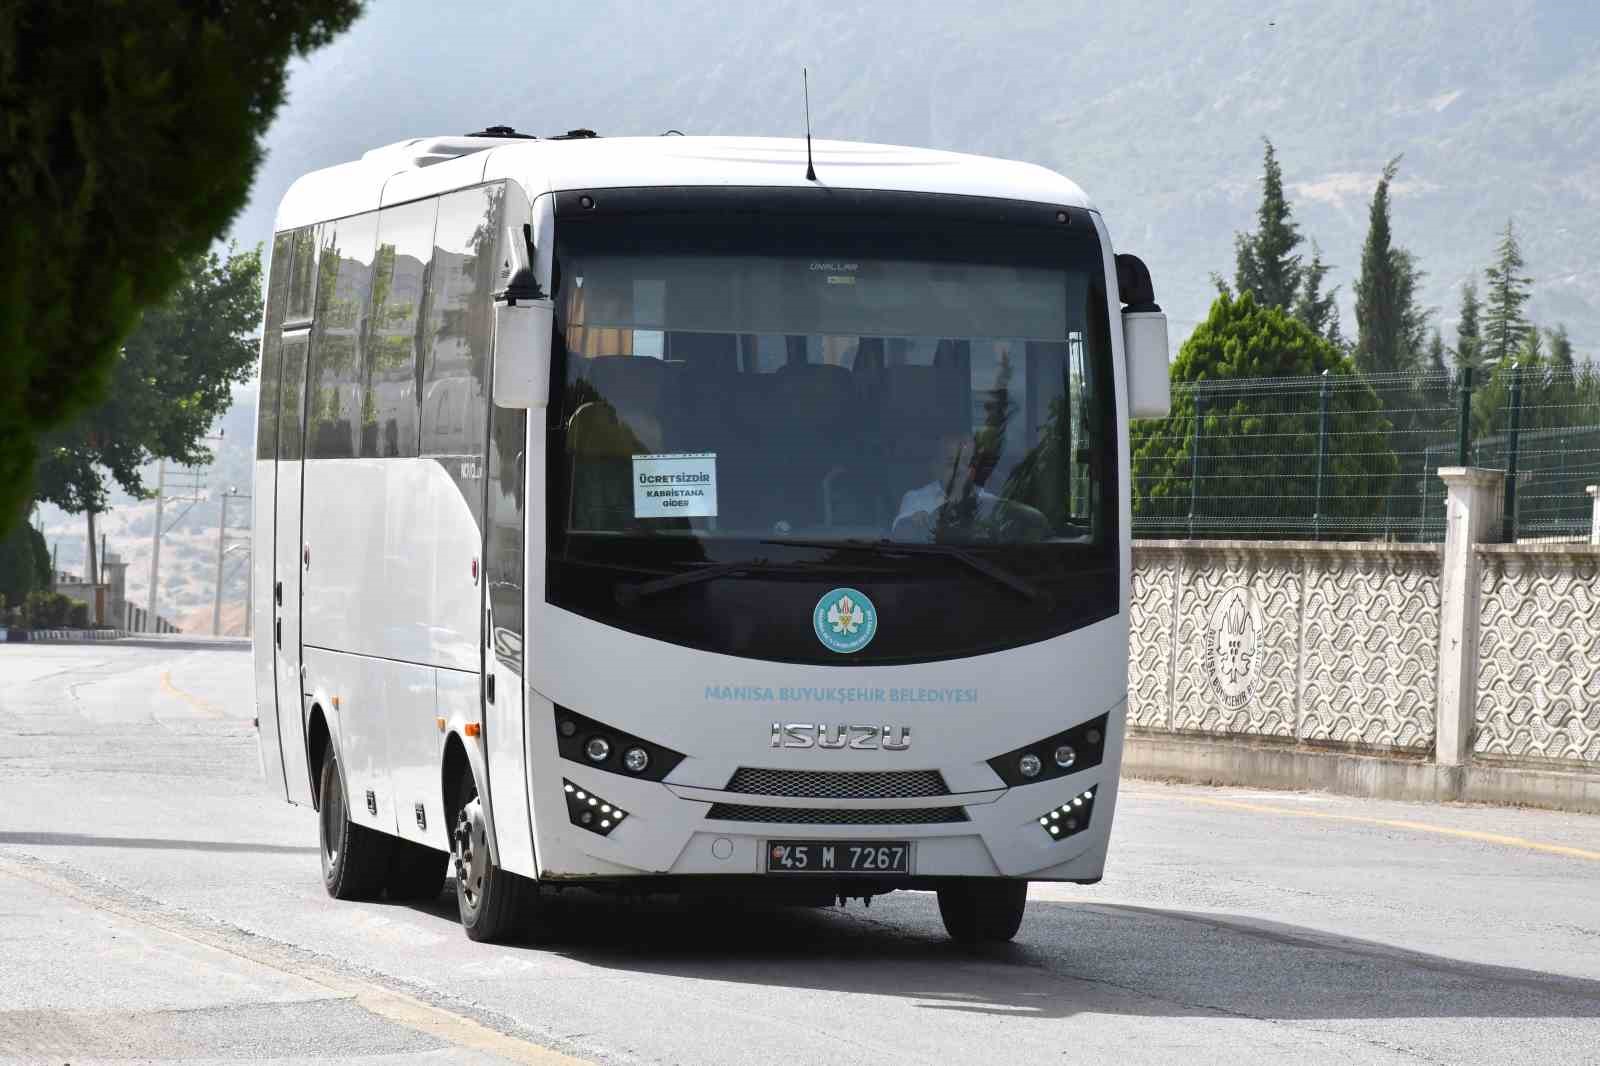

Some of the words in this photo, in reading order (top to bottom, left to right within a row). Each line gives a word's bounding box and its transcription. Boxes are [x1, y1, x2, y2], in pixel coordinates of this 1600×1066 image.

[639, 472, 711, 484] ÜCRETSİZDİR
[770, 721, 912, 750] ISUZU
[780, 846, 808, 869] 45
[822, 847, 835, 869] M
[849, 846, 904, 869] 7267
